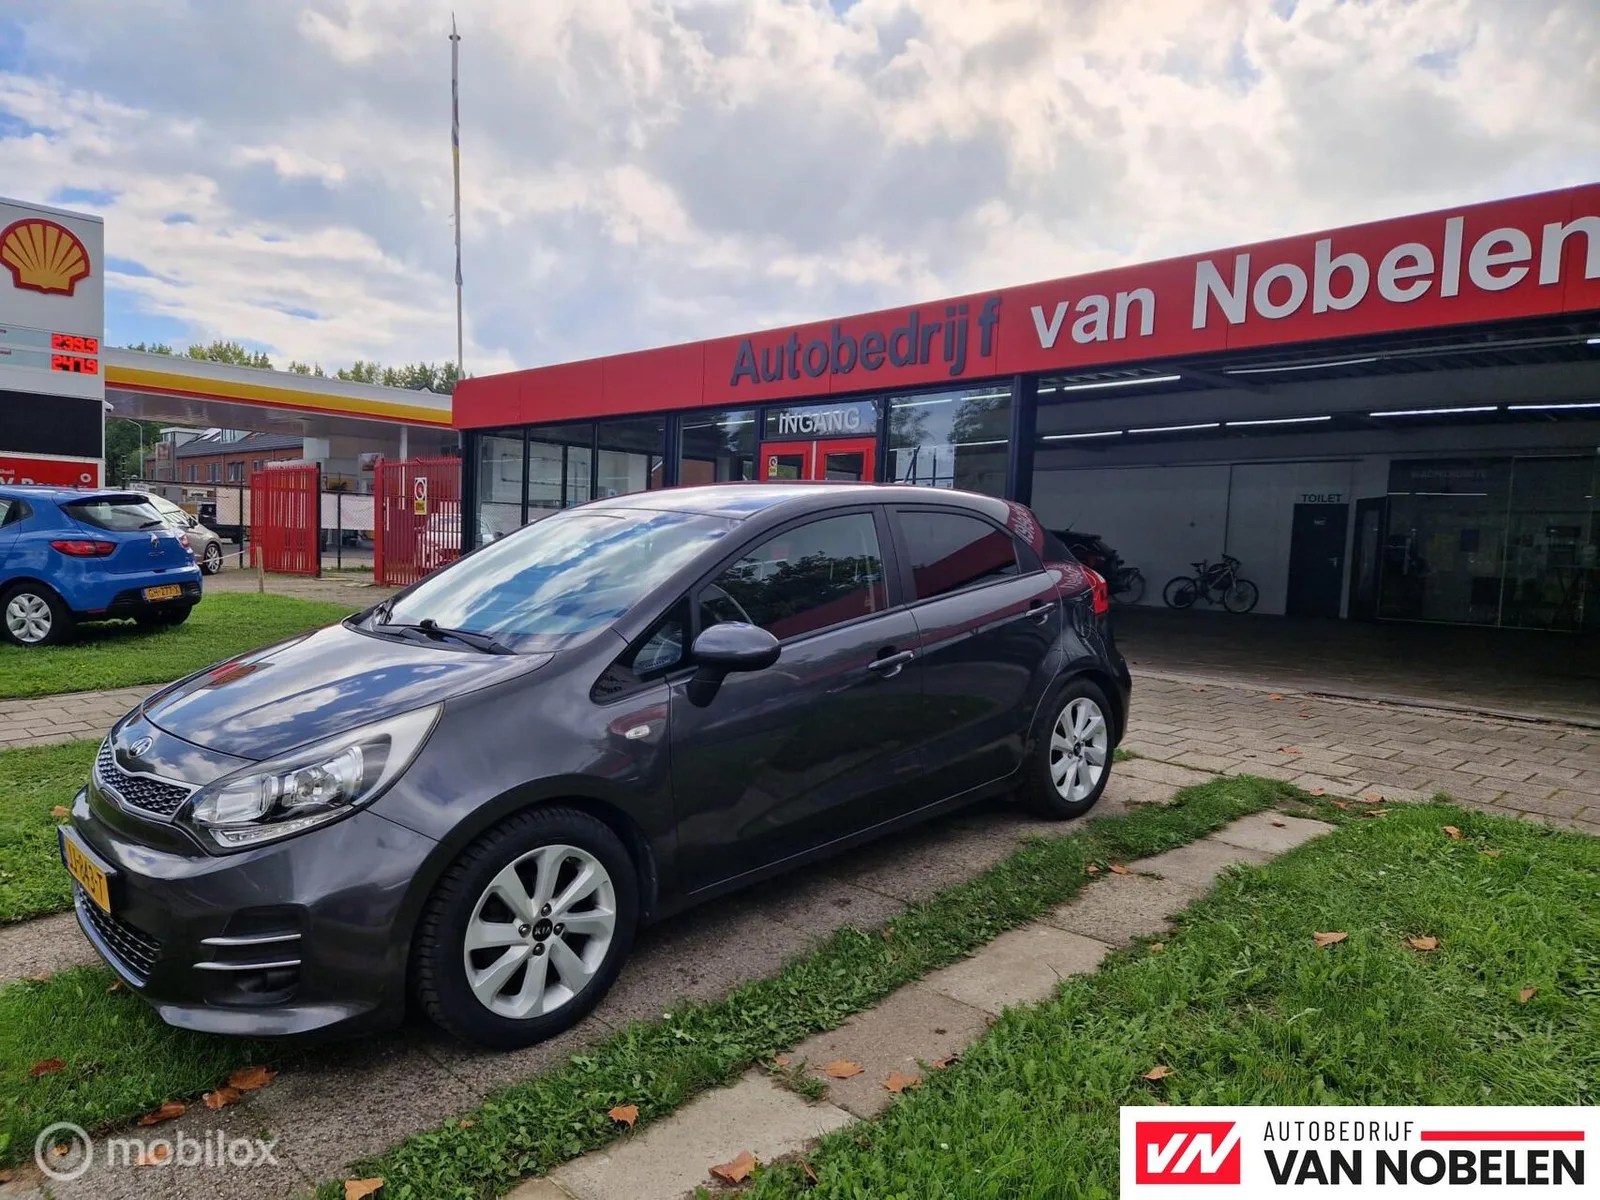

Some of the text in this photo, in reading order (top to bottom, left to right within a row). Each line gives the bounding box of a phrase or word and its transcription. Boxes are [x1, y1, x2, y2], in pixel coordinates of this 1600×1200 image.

[1030, 286, 1155, 350] van
[1191, 214, 1600, 330] Nobelen
[778, 408, 861, 434] INGANG
[1301, 493, 1343, 504] TOILET
